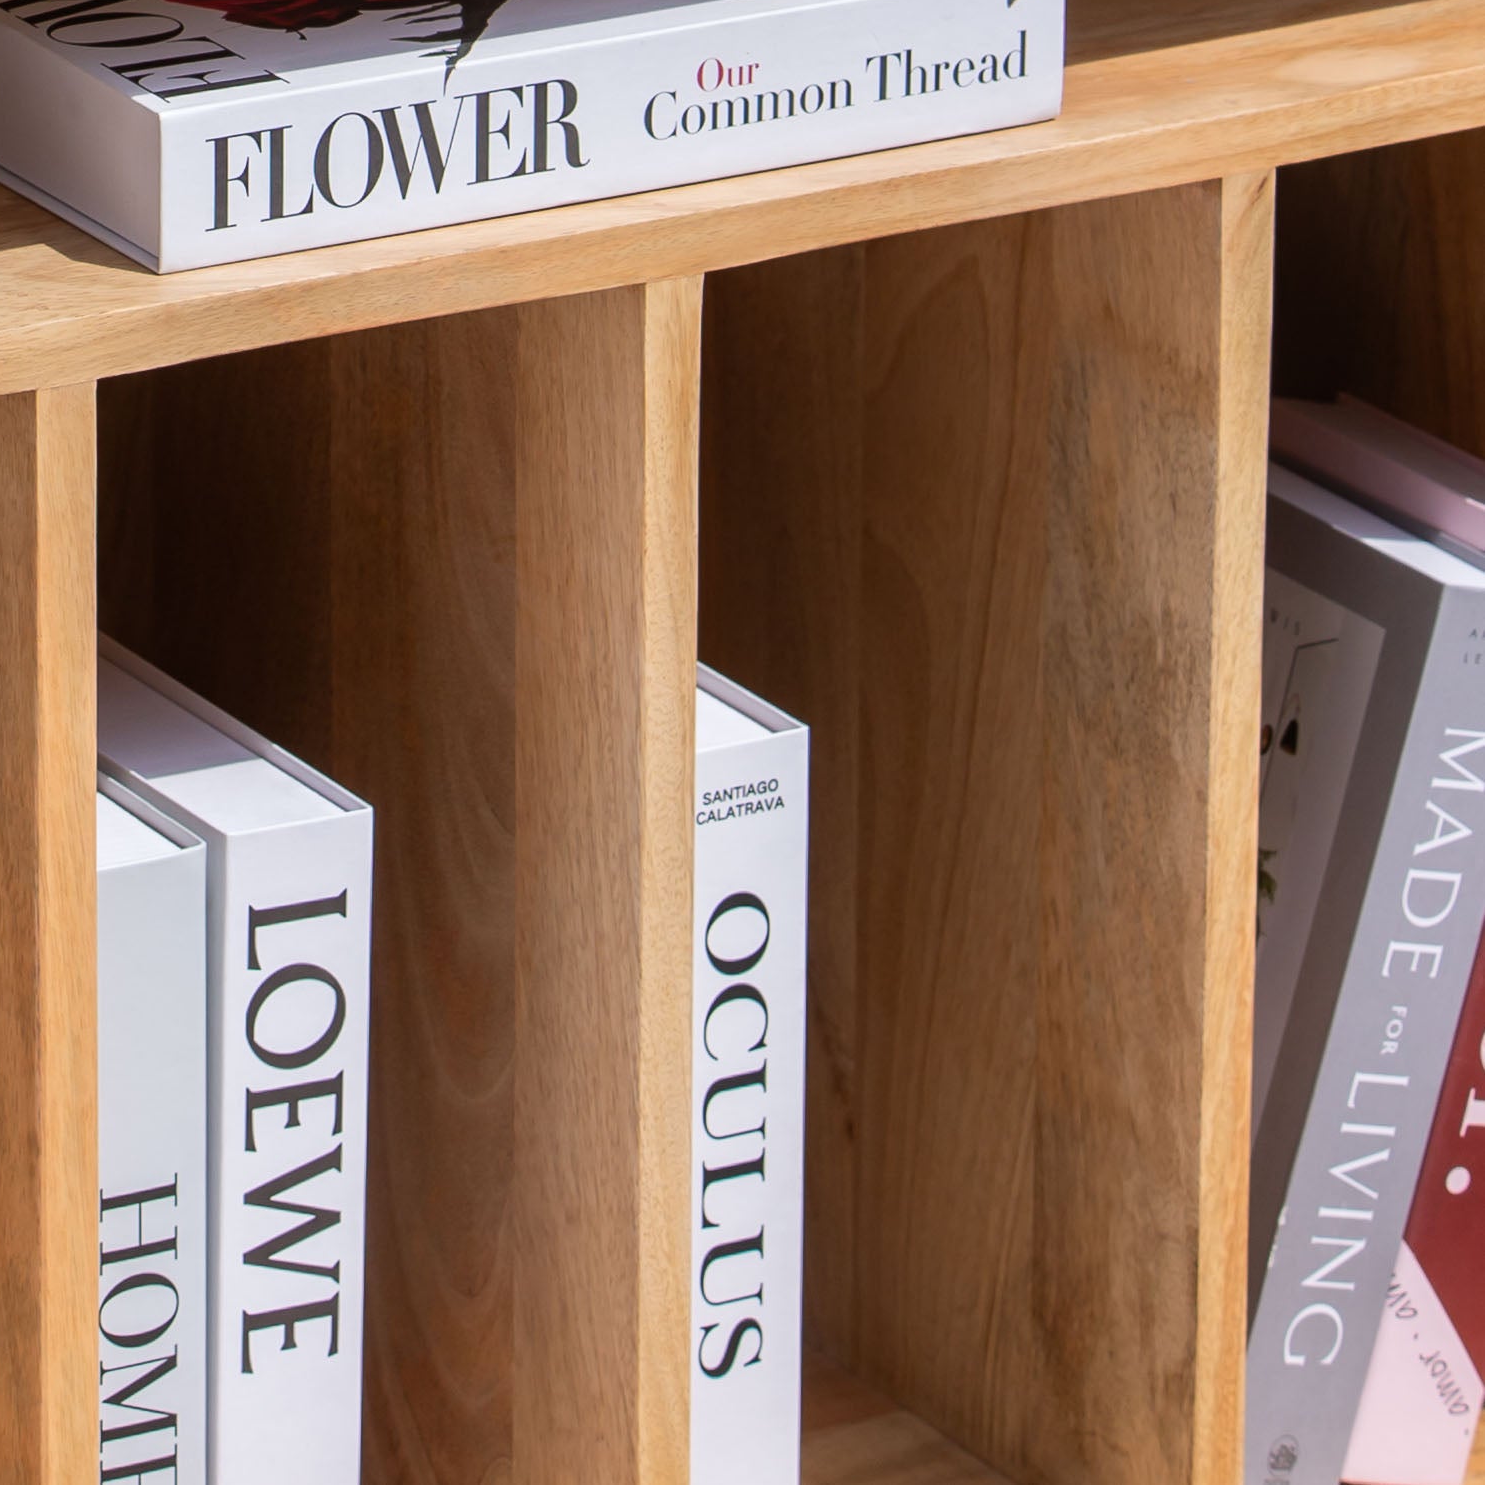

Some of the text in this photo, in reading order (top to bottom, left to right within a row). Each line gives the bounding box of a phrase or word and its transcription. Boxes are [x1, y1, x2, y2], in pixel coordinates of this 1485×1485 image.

[643, 30, 1028, 141] Common Thread
[697, 57, 760, 93] Our
[203, 77, 590, 232] FLOWER
[696, 796, 785, 826] CALATRAVA
[702, 778, 779, 806] SANTIAGO
[1380, 1004, 1408, 1056] FOR
[241, 887, 348, 1375] LOEWE
[698, 891, 771, 1379] OCULUS
[1282, 1070, 1410, 1367] LIVING
[1418, 1349, 1470, 1417] amor
